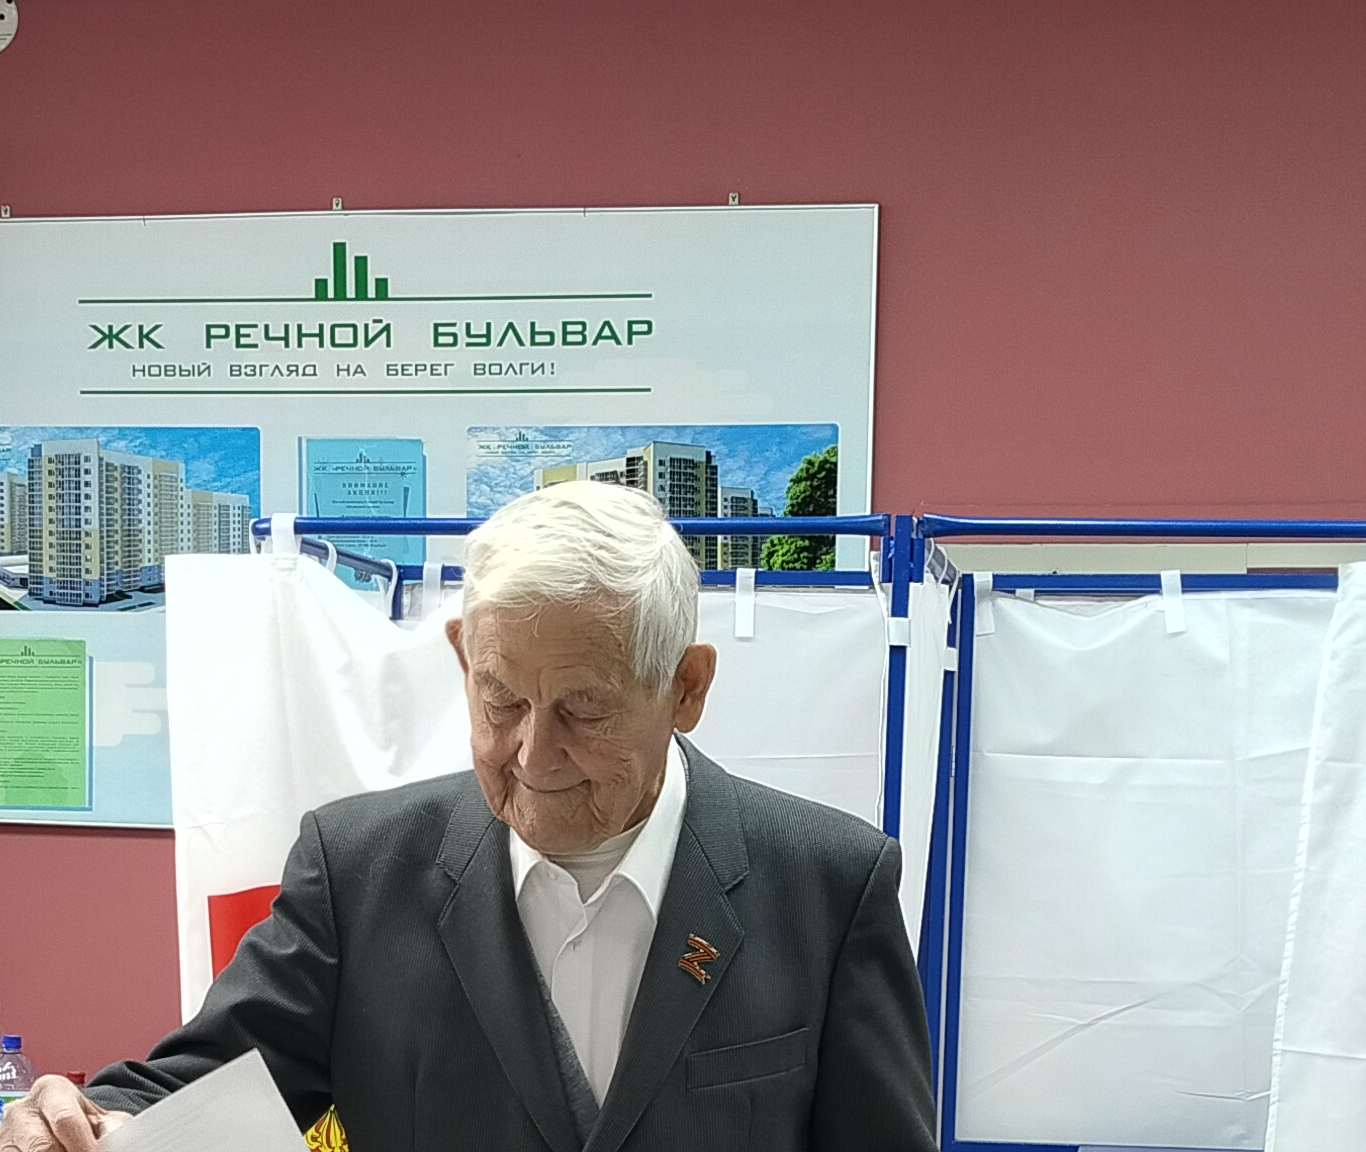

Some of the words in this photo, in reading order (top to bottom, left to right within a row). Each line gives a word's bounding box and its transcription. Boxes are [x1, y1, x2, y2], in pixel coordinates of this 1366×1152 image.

[87, 324, 165, 350] ЖК
[205, 319, 392, 349] РЕЧНОЙ
[433, 320, 654, 348] БУЛЬВАР
[132, 363, 212, 378] НОВЫЙ
[230, 364, 318, 377] ВЗГЛЯД
[337, 364, 367, 377] НА
[386, 363, 455, 376] БЕРЕГ
[473, 362, 556, 376] ВОЛГИ!
